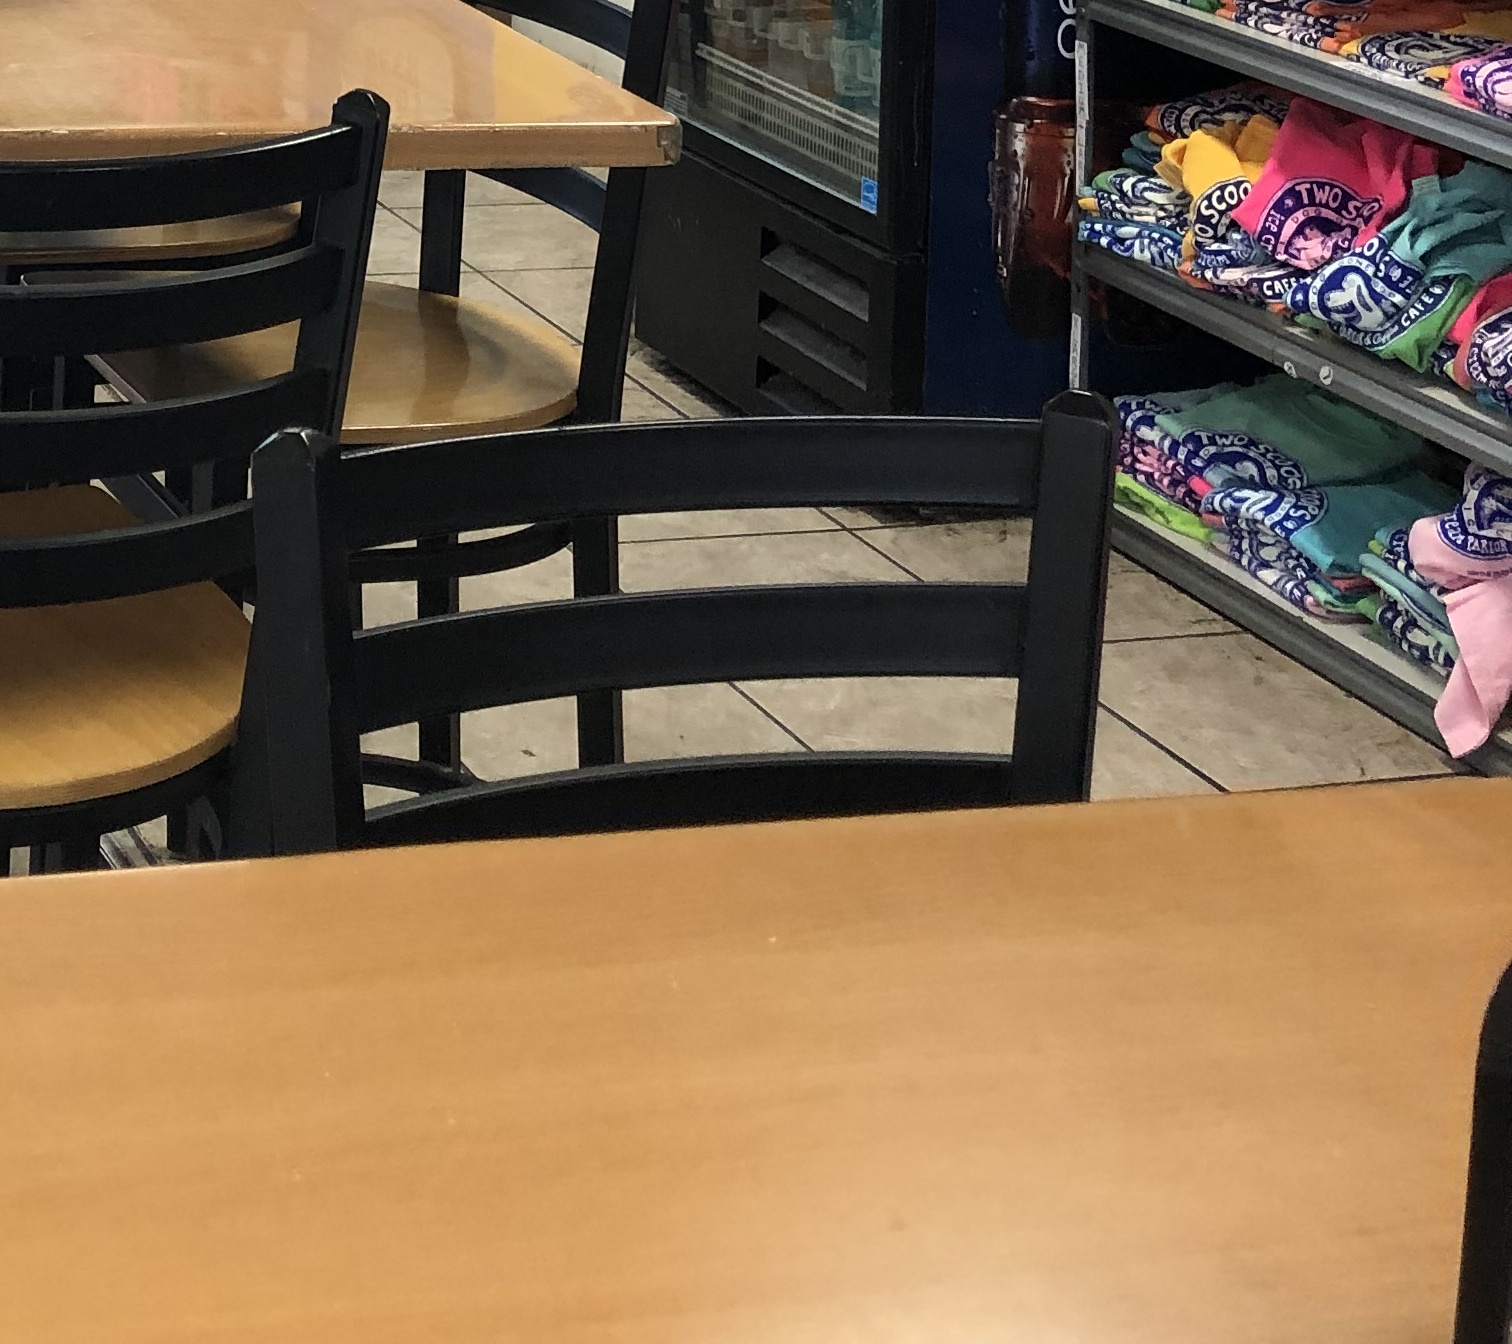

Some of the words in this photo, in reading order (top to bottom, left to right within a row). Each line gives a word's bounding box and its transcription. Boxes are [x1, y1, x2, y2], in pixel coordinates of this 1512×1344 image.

[1294, 183, 1343, 209] TWO
[1400, 291, 1435, 327] CAFE
[1194, 430, 1248, 446] TWO
[1467, 535, 1508, 555] PARLOR
